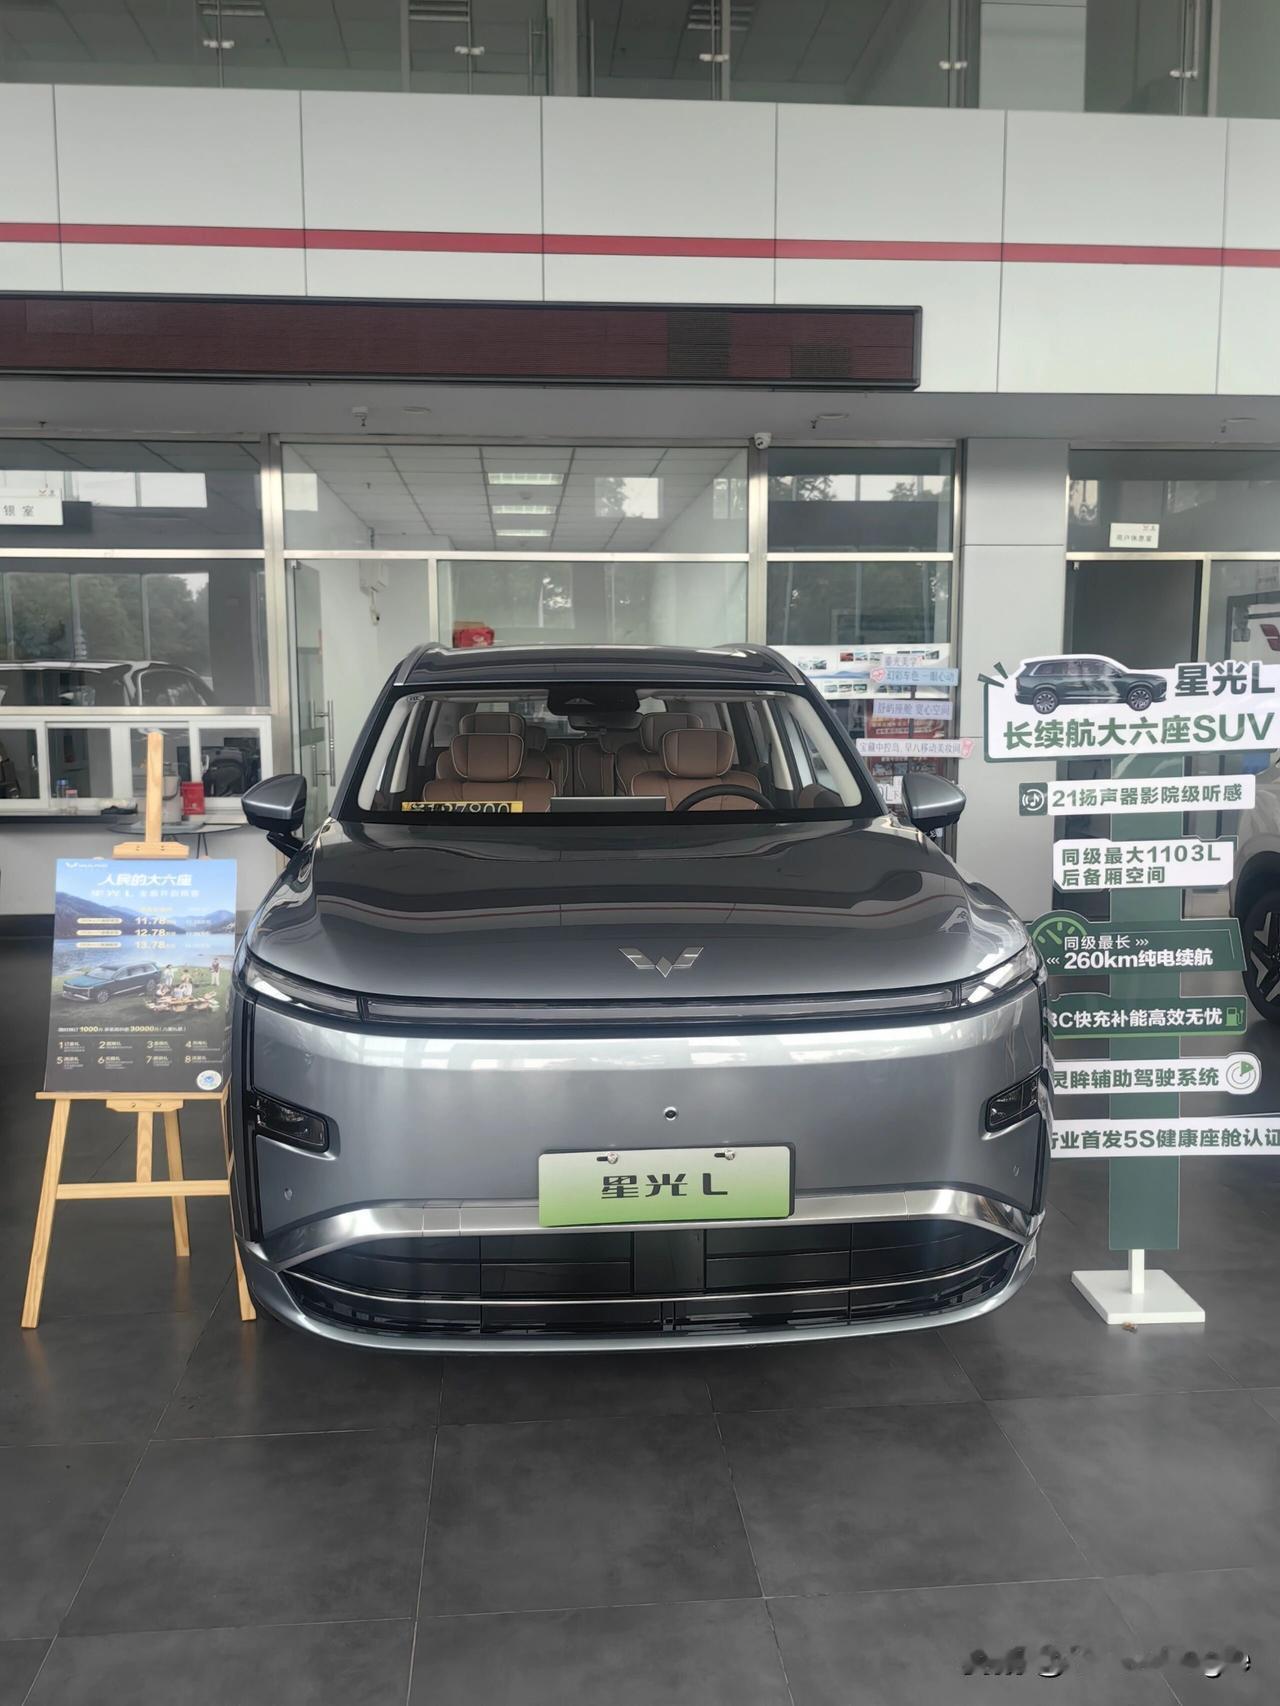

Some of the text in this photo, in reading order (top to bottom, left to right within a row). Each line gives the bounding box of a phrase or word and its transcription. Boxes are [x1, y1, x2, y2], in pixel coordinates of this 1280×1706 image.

[1175, 662, 1276, 698] 星光L
[1003, 712, 1275, 750] 长续航大六座SUV
[1052, 783, 1243, 808] 21扬声器影院级听感
[1062, 844, 1221, 866] 同级最大1103L
[1062, 866, 1166, 887] 后备厢空间
[1064, 935, 1131, 950] 同级最长
[1064, 947, 1213, 970] 260km纯电续航
[1053, 1067, 1220, 1089] 灵眸辅助驾驶系统
